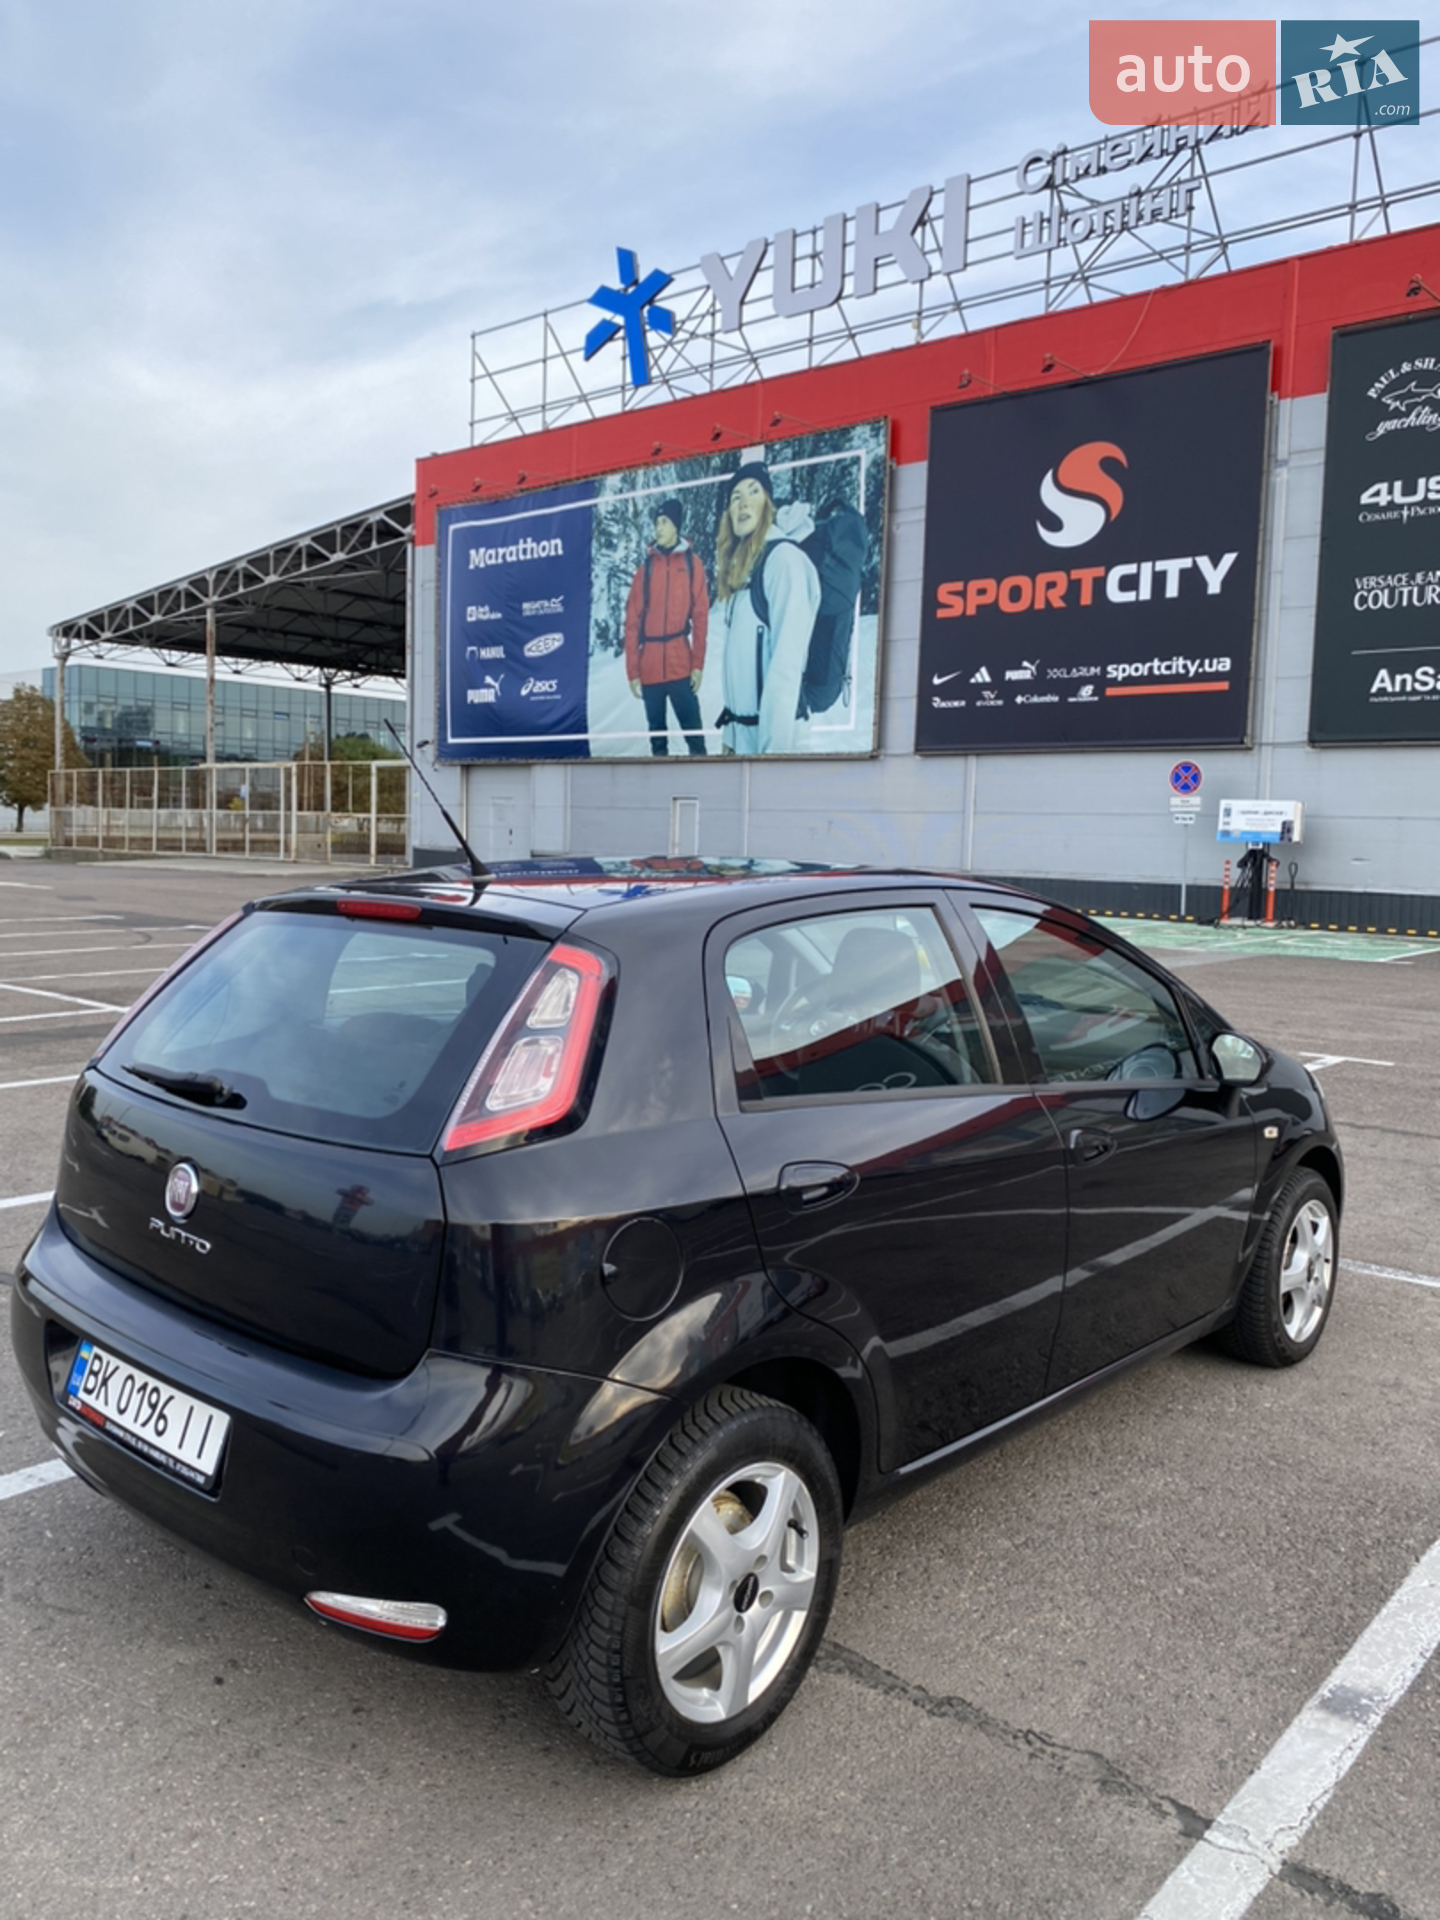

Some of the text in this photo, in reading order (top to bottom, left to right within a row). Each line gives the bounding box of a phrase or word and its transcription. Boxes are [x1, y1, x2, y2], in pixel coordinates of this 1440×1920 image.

[1015, 80, 1272, 195] Сімейний
[1013, 180, 1202, 260] Шопінг
[700, 173, 971, 334] YUKI
[1366, 367, 1400, 399] PAUL
[1400, 361, 1412, 374] &
[468, 537, 564, 570] Marathon
[936, 551, 1239, 619] SPORTCITY
[1355, 572, 1409, 590] VERSACE
[525, 637, 562, 653] KEEN
[1106, 656, 1231, 682] sportcity.ua
[149, 1217, 212, 1255] PUNTO
[82, 1352, 120, 1408] BK
[117, 1373, 176, 1438] 0196
